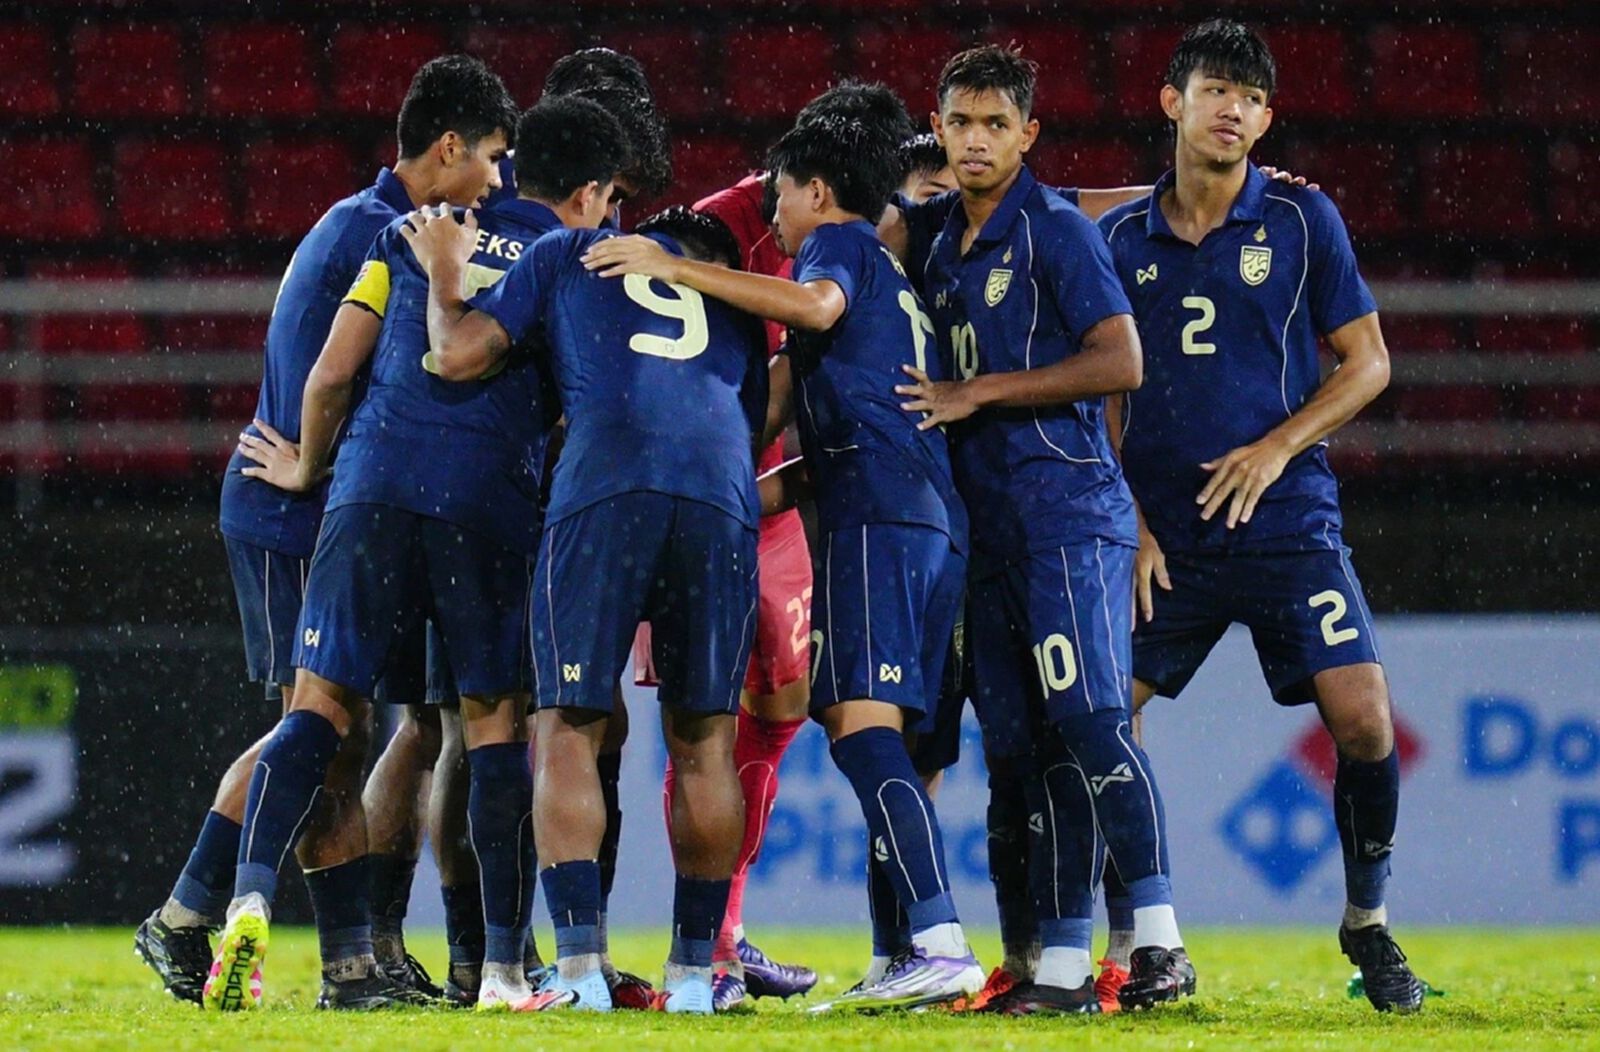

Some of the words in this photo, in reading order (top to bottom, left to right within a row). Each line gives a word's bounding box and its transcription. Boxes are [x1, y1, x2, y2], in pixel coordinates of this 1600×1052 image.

[624, 272, 709, 360] 9
[1182, 296, 1216, 354] 2
[951, 321, 979, 383] 10
[1308, 590, 1359, 646] 2
[1032, 633, 1077, 700] 10
